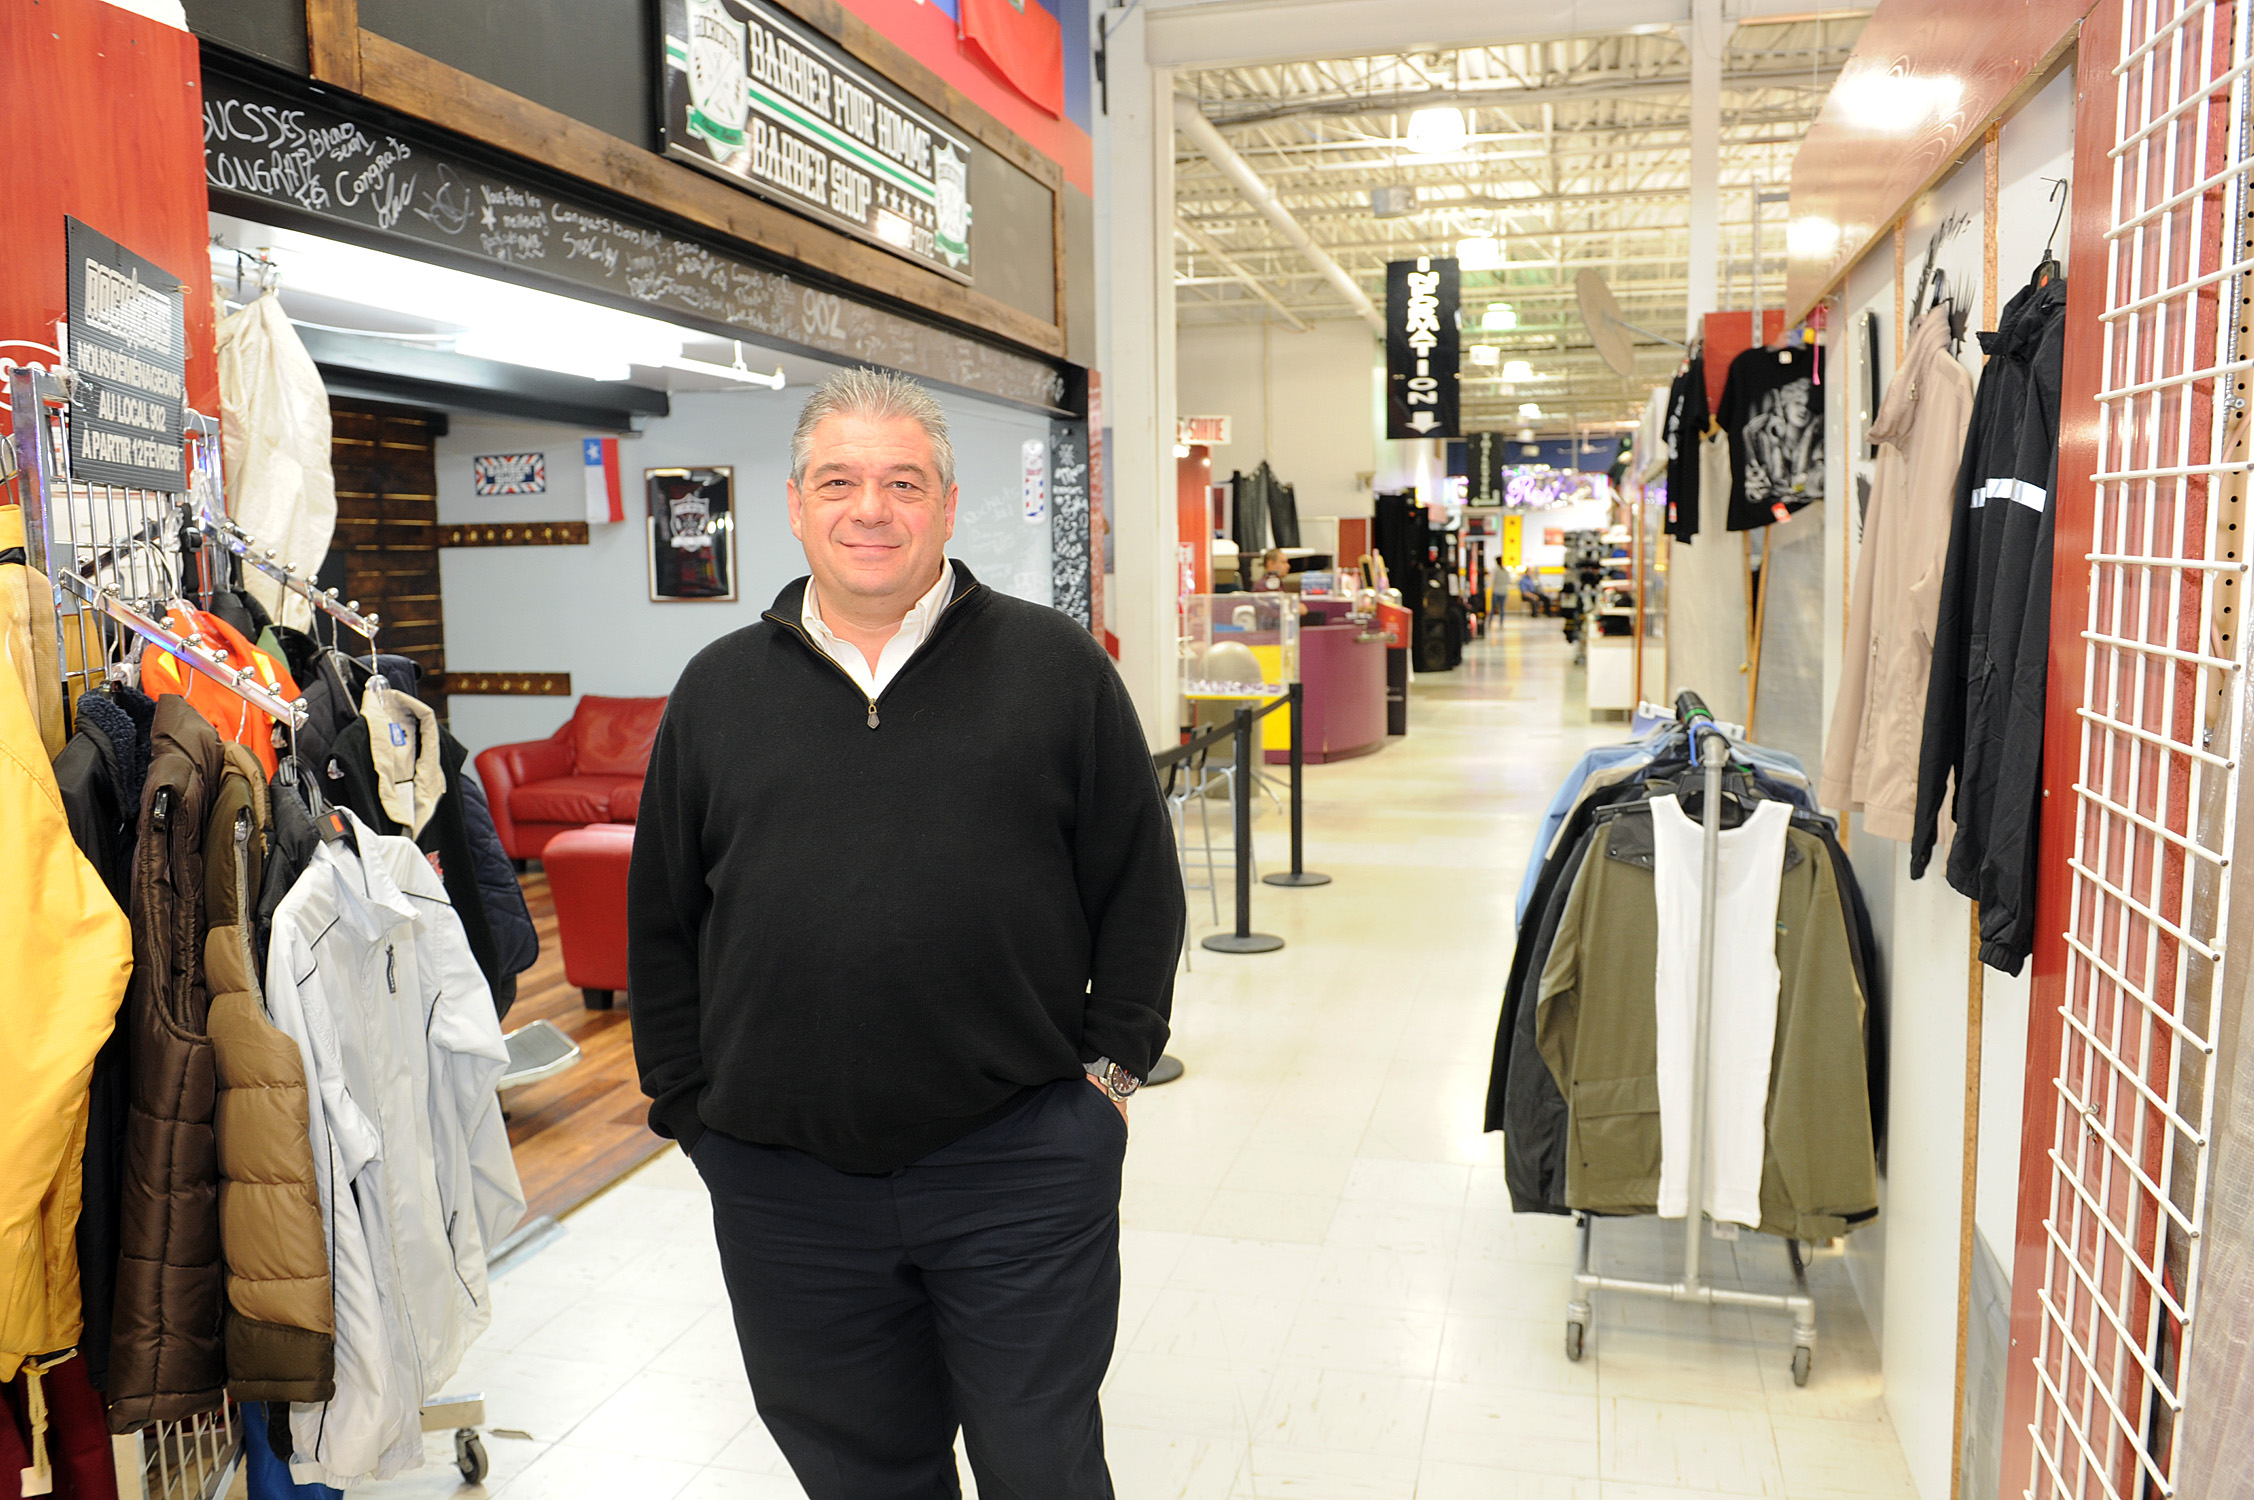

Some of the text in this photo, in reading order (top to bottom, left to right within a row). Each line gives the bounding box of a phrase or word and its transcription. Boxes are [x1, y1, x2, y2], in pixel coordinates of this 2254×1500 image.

[748, 19, 833, 120] BARBIER
[833, 74, 876, 147] POUR
[876, 102, 933, 178] HOMME
[752, 117, 872, 223] BARBER SHOP
[802, 288, 846, 339] 902
[76, 340, 111, 379] NOUS
[98, 389, 167, 433] AU LOCAL 902
[82, 421, 181, 472] À PARTIR 12 FÉVRIER
